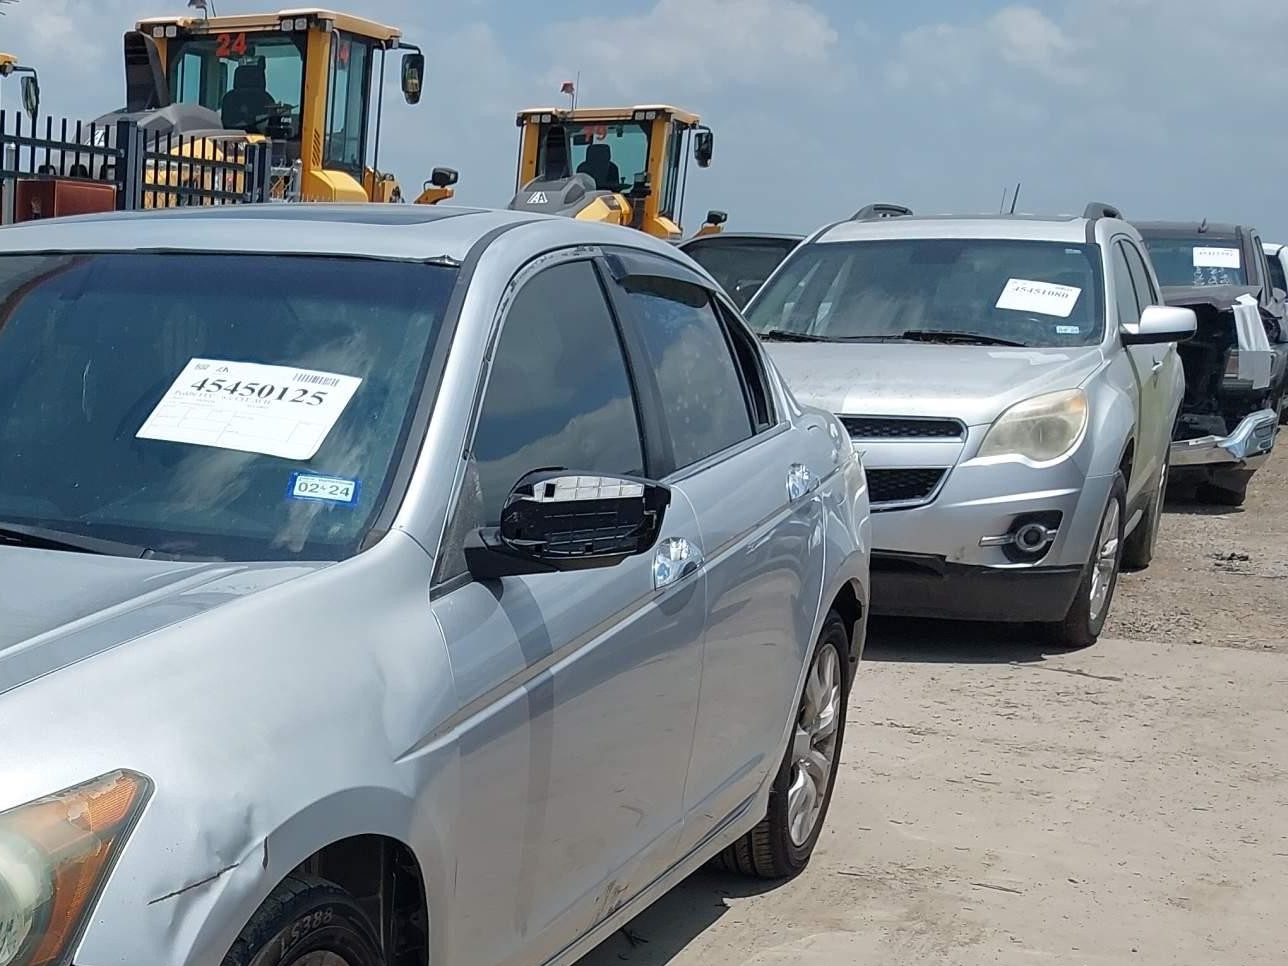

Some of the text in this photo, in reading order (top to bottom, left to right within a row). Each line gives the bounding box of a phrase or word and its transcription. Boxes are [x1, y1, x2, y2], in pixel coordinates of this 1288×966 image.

[216, 32, 247, 57] 24
[190, 377, 329, 406] 45450125
[298, 482, 350, 497] 02 24
[279, 907, 333, 959] LS388
